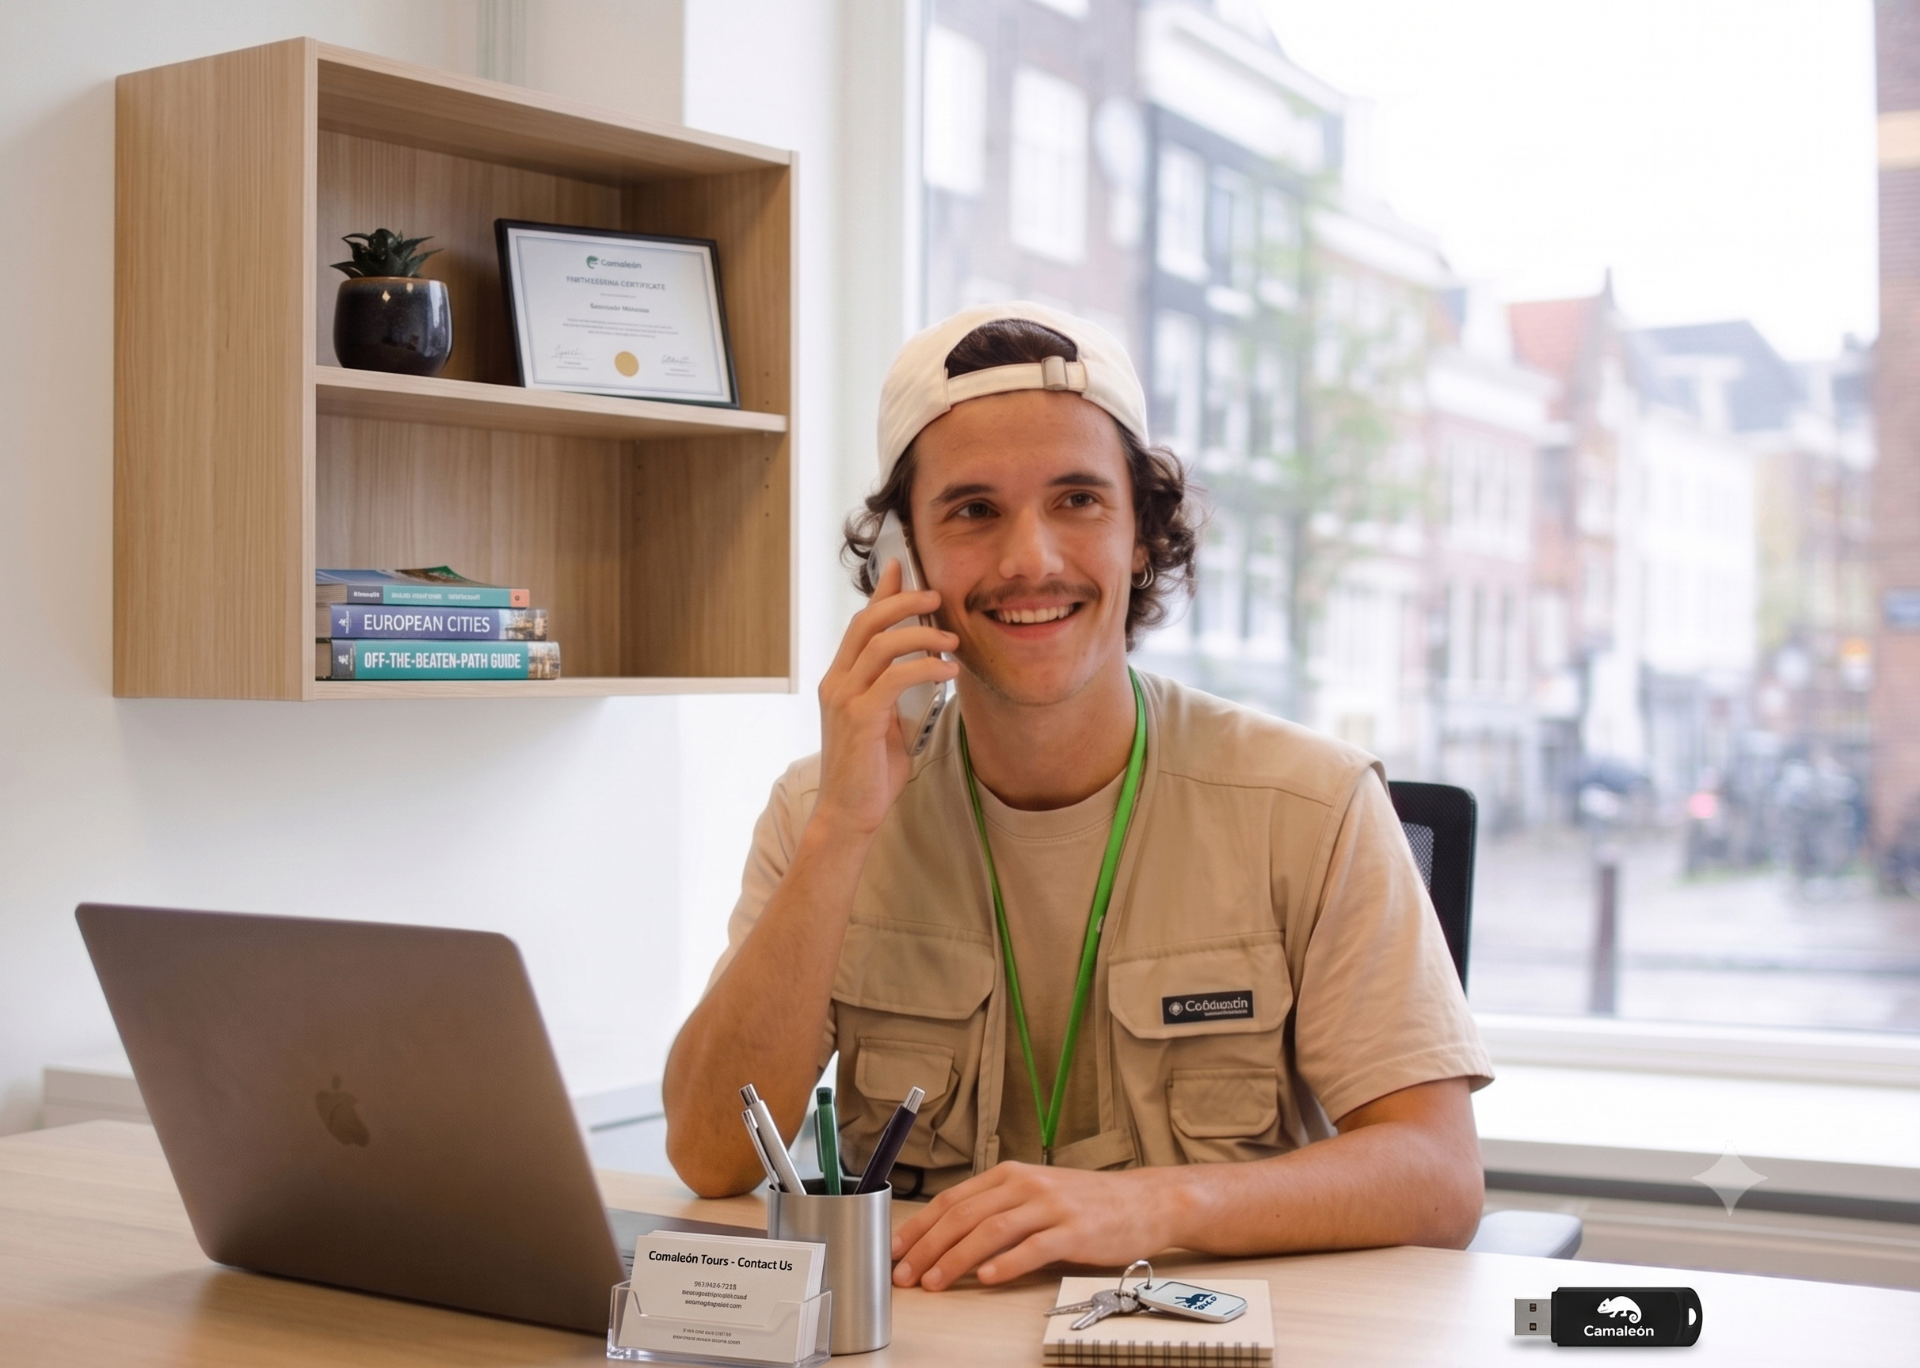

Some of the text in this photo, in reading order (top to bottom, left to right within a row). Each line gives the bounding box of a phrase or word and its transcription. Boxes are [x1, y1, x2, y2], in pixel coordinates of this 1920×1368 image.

[620, 280, 666, 291] CERTIFICATE
[363, 614, 443, 632] EUROPEAN
[447, 616, 490, 633] CITIES
[364, 652, 488, 669] OFF-THE-BEATEN-PATH
[491, 653, 522, 669] GUIDE
[648, 1250, 699, 1265] Comaleón
[701, 1254, 729, 1267] Tours
[738, 1257, 777, 1270] Contact
[779, 1261, 793, 1272] Us
[1584, 1325, 1654, 1337] Camaleón
